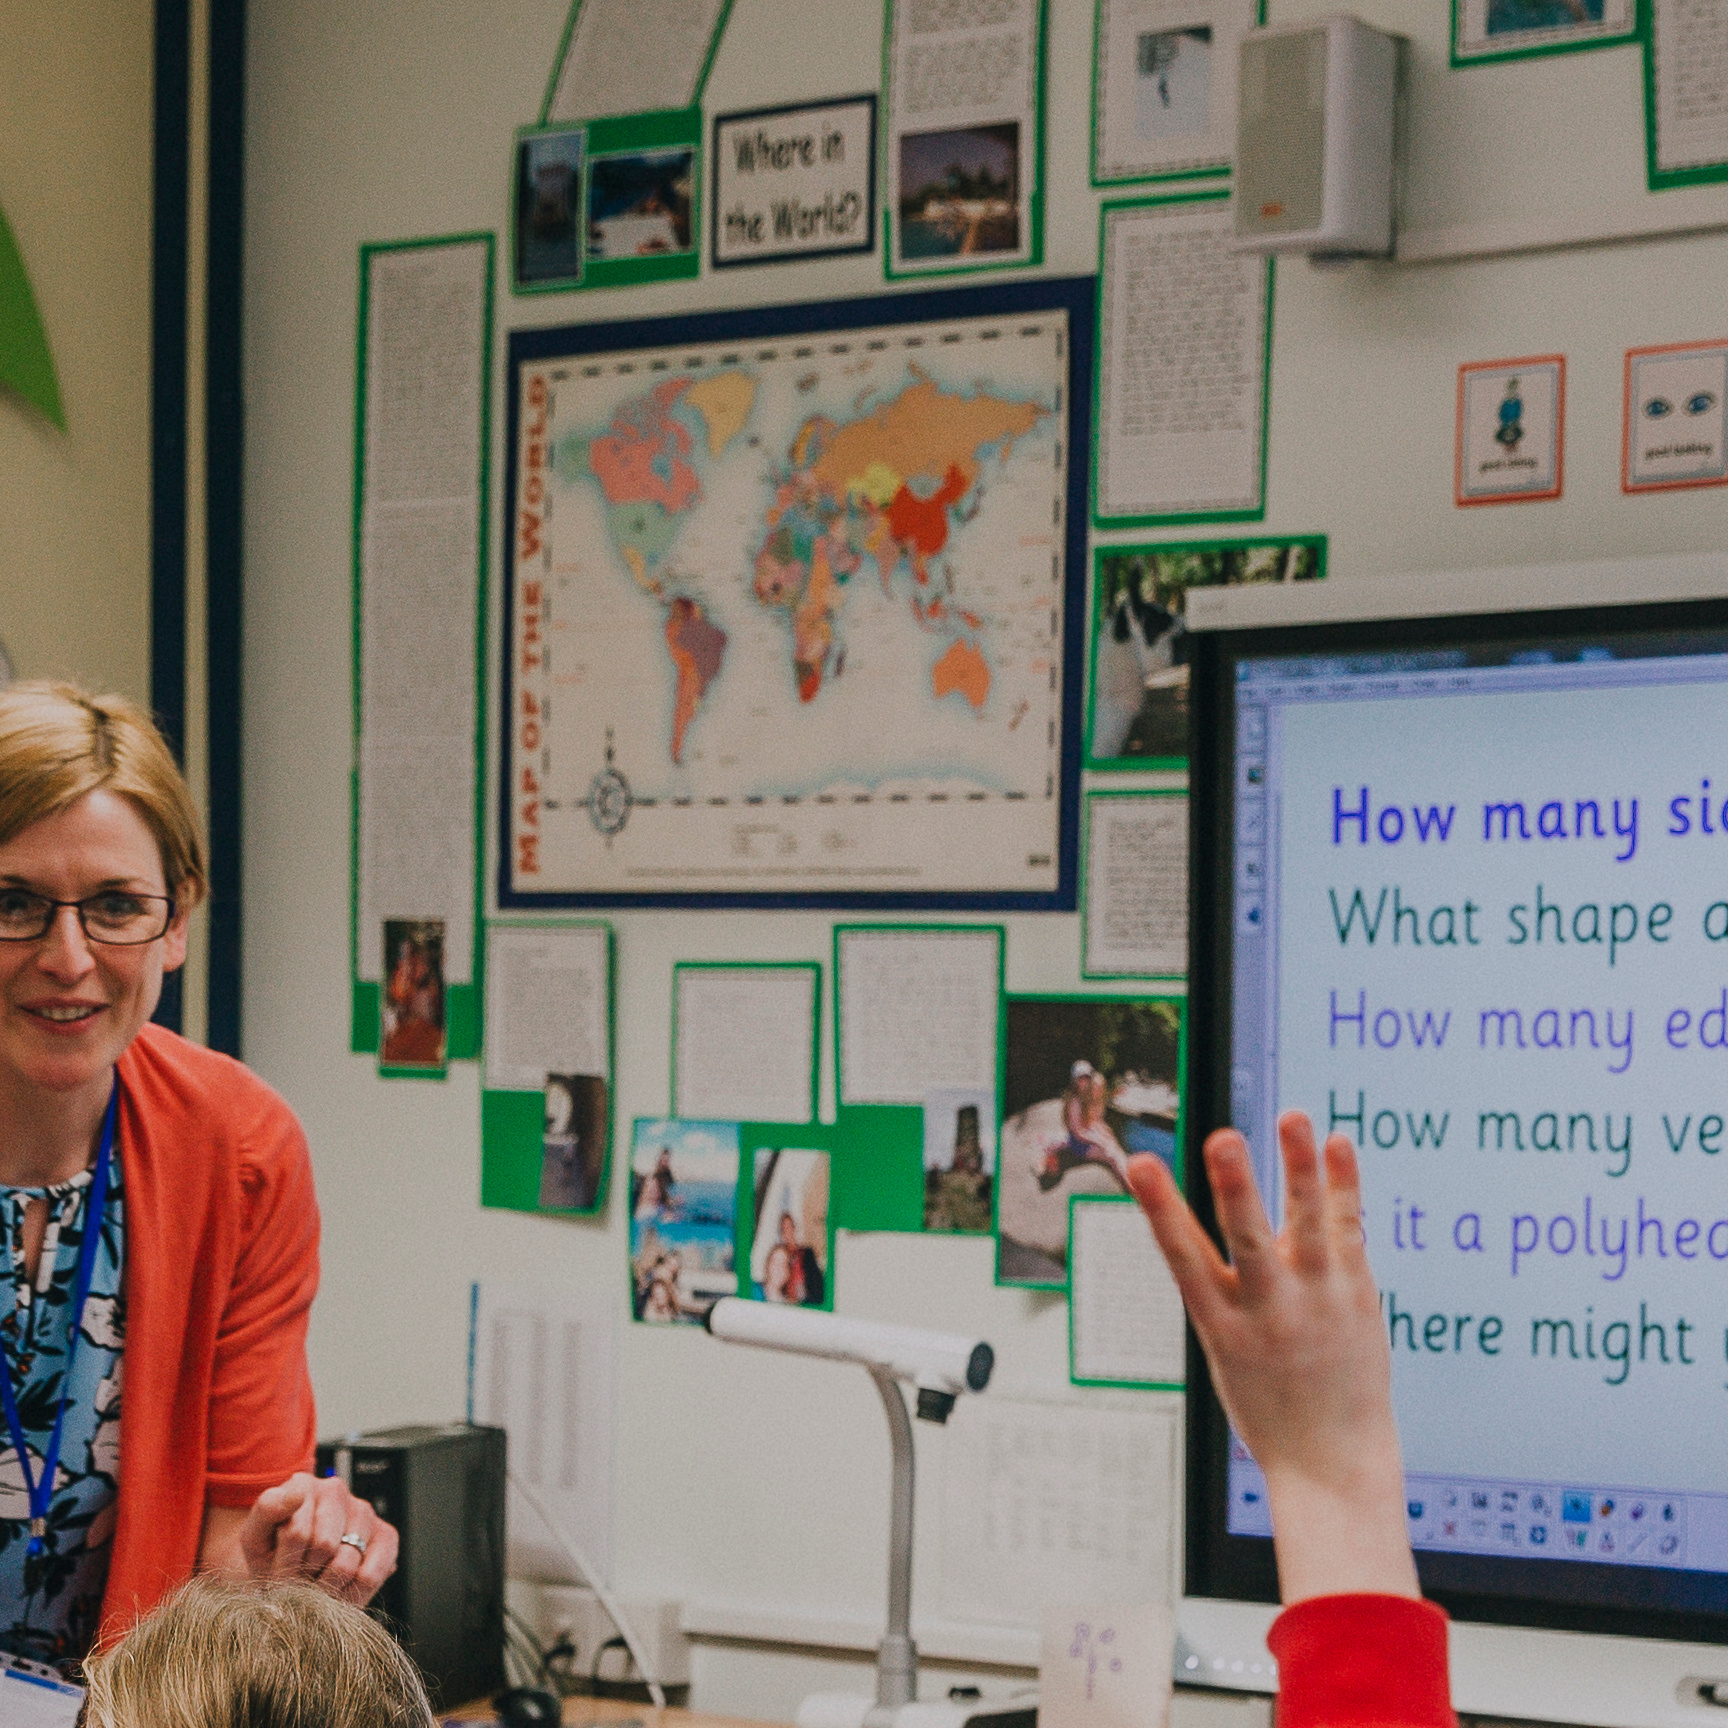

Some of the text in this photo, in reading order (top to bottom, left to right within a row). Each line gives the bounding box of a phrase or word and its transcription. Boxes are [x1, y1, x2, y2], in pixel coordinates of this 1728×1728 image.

[731, 124, 847, 174] Where in
[723, 189, 864, 246] the World?
[519, 375, 548, 875] MAP OF THE WORLD
[1329, 784, 1458, 848] How
[1481, 795, 1640, 864] many
[1327, 885, 1483, 948] What
[1505, 884, 1675, 968] shape
[1327, 986, 1453, 1051] How
[1477, 1002, 1637, 1075] many
[1327, 1088, 1452, 1152] How
[1476, 1105, 1636, 1179] many
[1392, 1196, 1428, 1255] it
[1451, 1208, 1485, 1256] a
[1378, 1289, 1505, 1358] here
[1529, 1299, 1697, 1388] might
